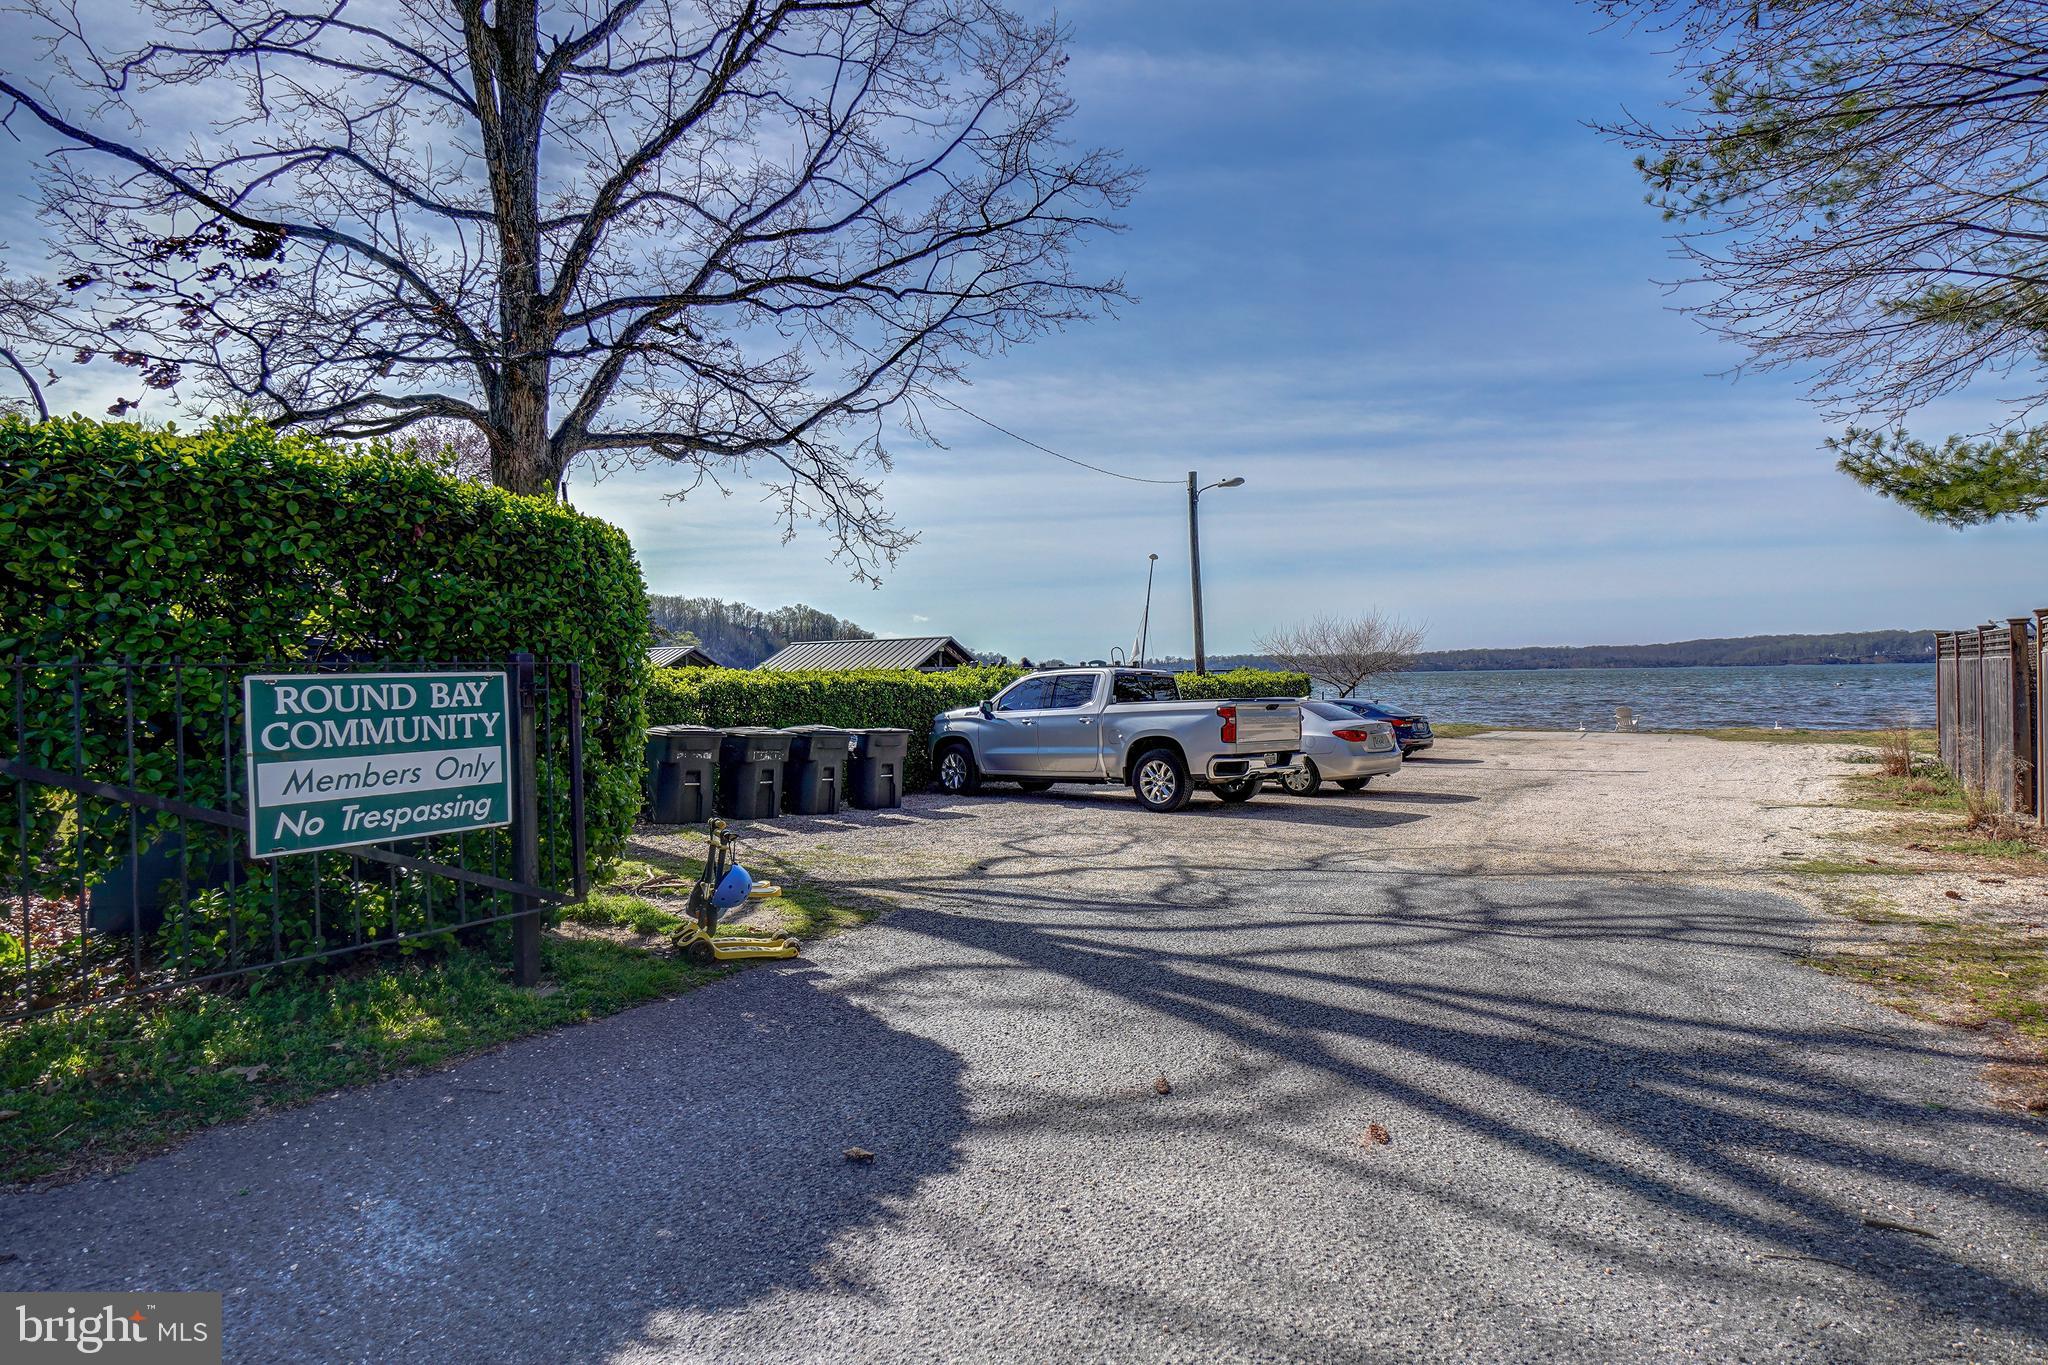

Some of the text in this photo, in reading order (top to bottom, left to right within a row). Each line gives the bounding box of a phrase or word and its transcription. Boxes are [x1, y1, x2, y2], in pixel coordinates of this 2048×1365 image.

[274, 681, 489, 715] ROUND BAY
[260, 712, 501, 751] COMMUNITY
[281, 753, 496, 796] Members Only
[273, 793, 492, 840] No Trespassing
